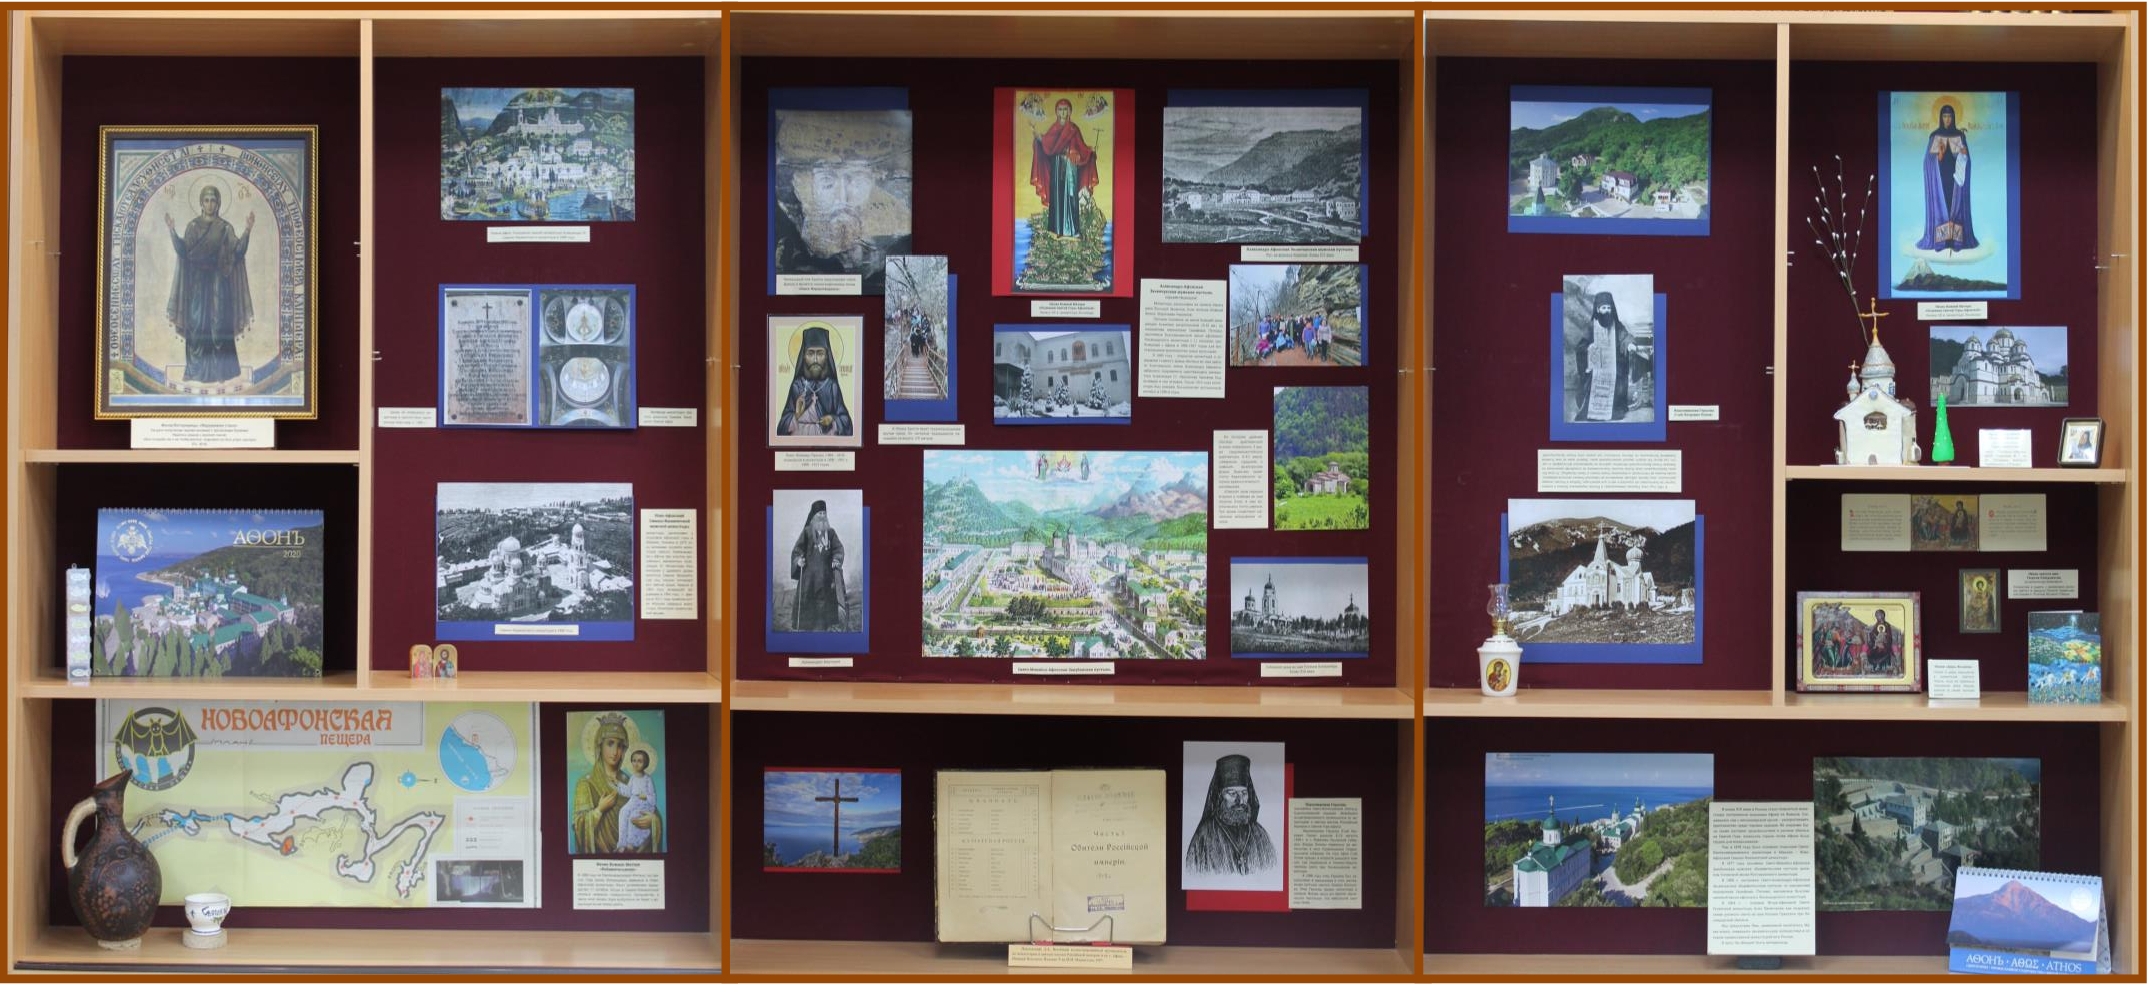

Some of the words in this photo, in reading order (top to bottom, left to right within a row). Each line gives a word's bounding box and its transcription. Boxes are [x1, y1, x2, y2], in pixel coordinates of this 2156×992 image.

[283, 550, 301, 558] 2020
[201, 708, 392, 731] НОВОАФОНСКАЯ
[320, 733, 372, 747] ПЕЩЕРА
[2046, 961, 2082, 973] ATHOS
